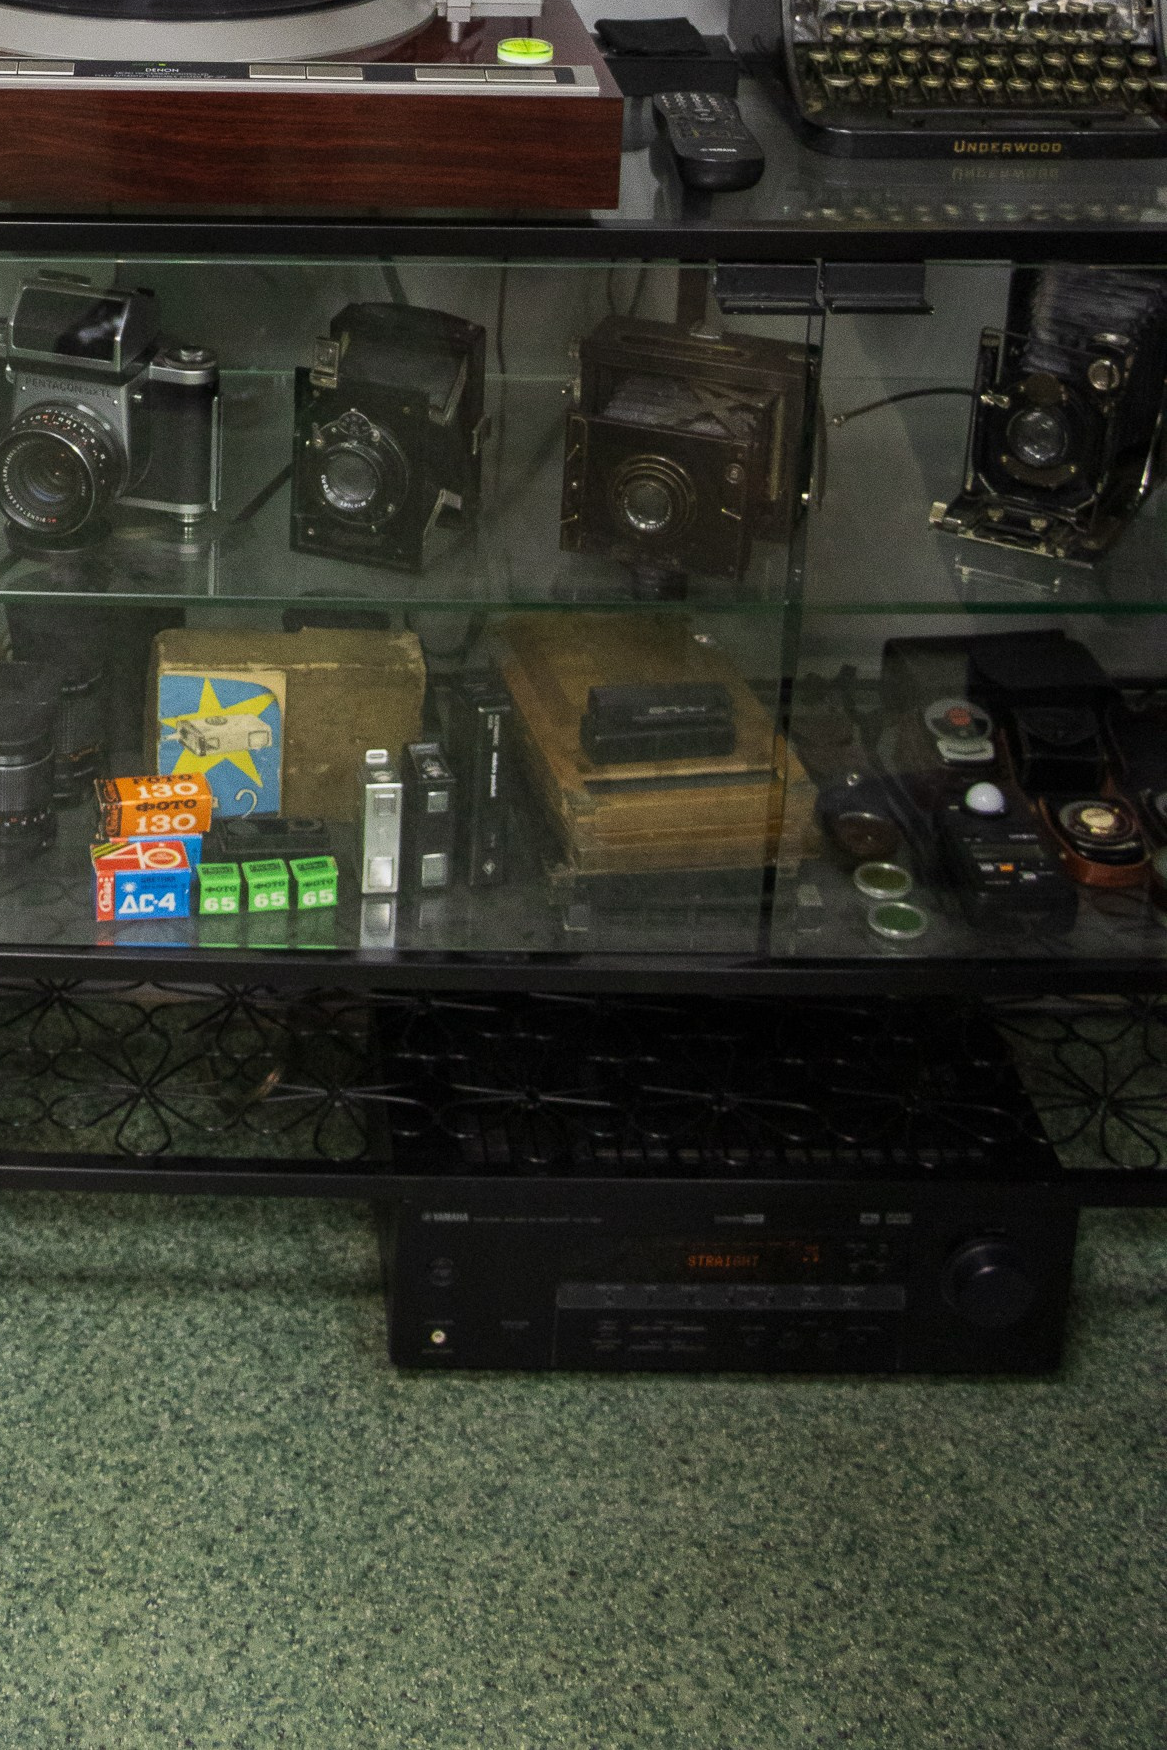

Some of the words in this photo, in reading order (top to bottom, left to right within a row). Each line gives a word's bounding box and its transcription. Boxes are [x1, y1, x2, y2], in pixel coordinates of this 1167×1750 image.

[952, 139, 1062, 154] UNDERWOOD
[136, 782, 199, 799] 130
[135, 799, 197, 812] ФОТО
[135, 813, 197, 833] 130
[205, 885, 237, 893] ФОТО
[253, 880, 286, 889] ФОТО
[302, 878, 334, 887] ФОТО
[204, 896, 236, 912] 65
[253, 891, 287, 908] 65
[302, 889, 335, 906] 65
